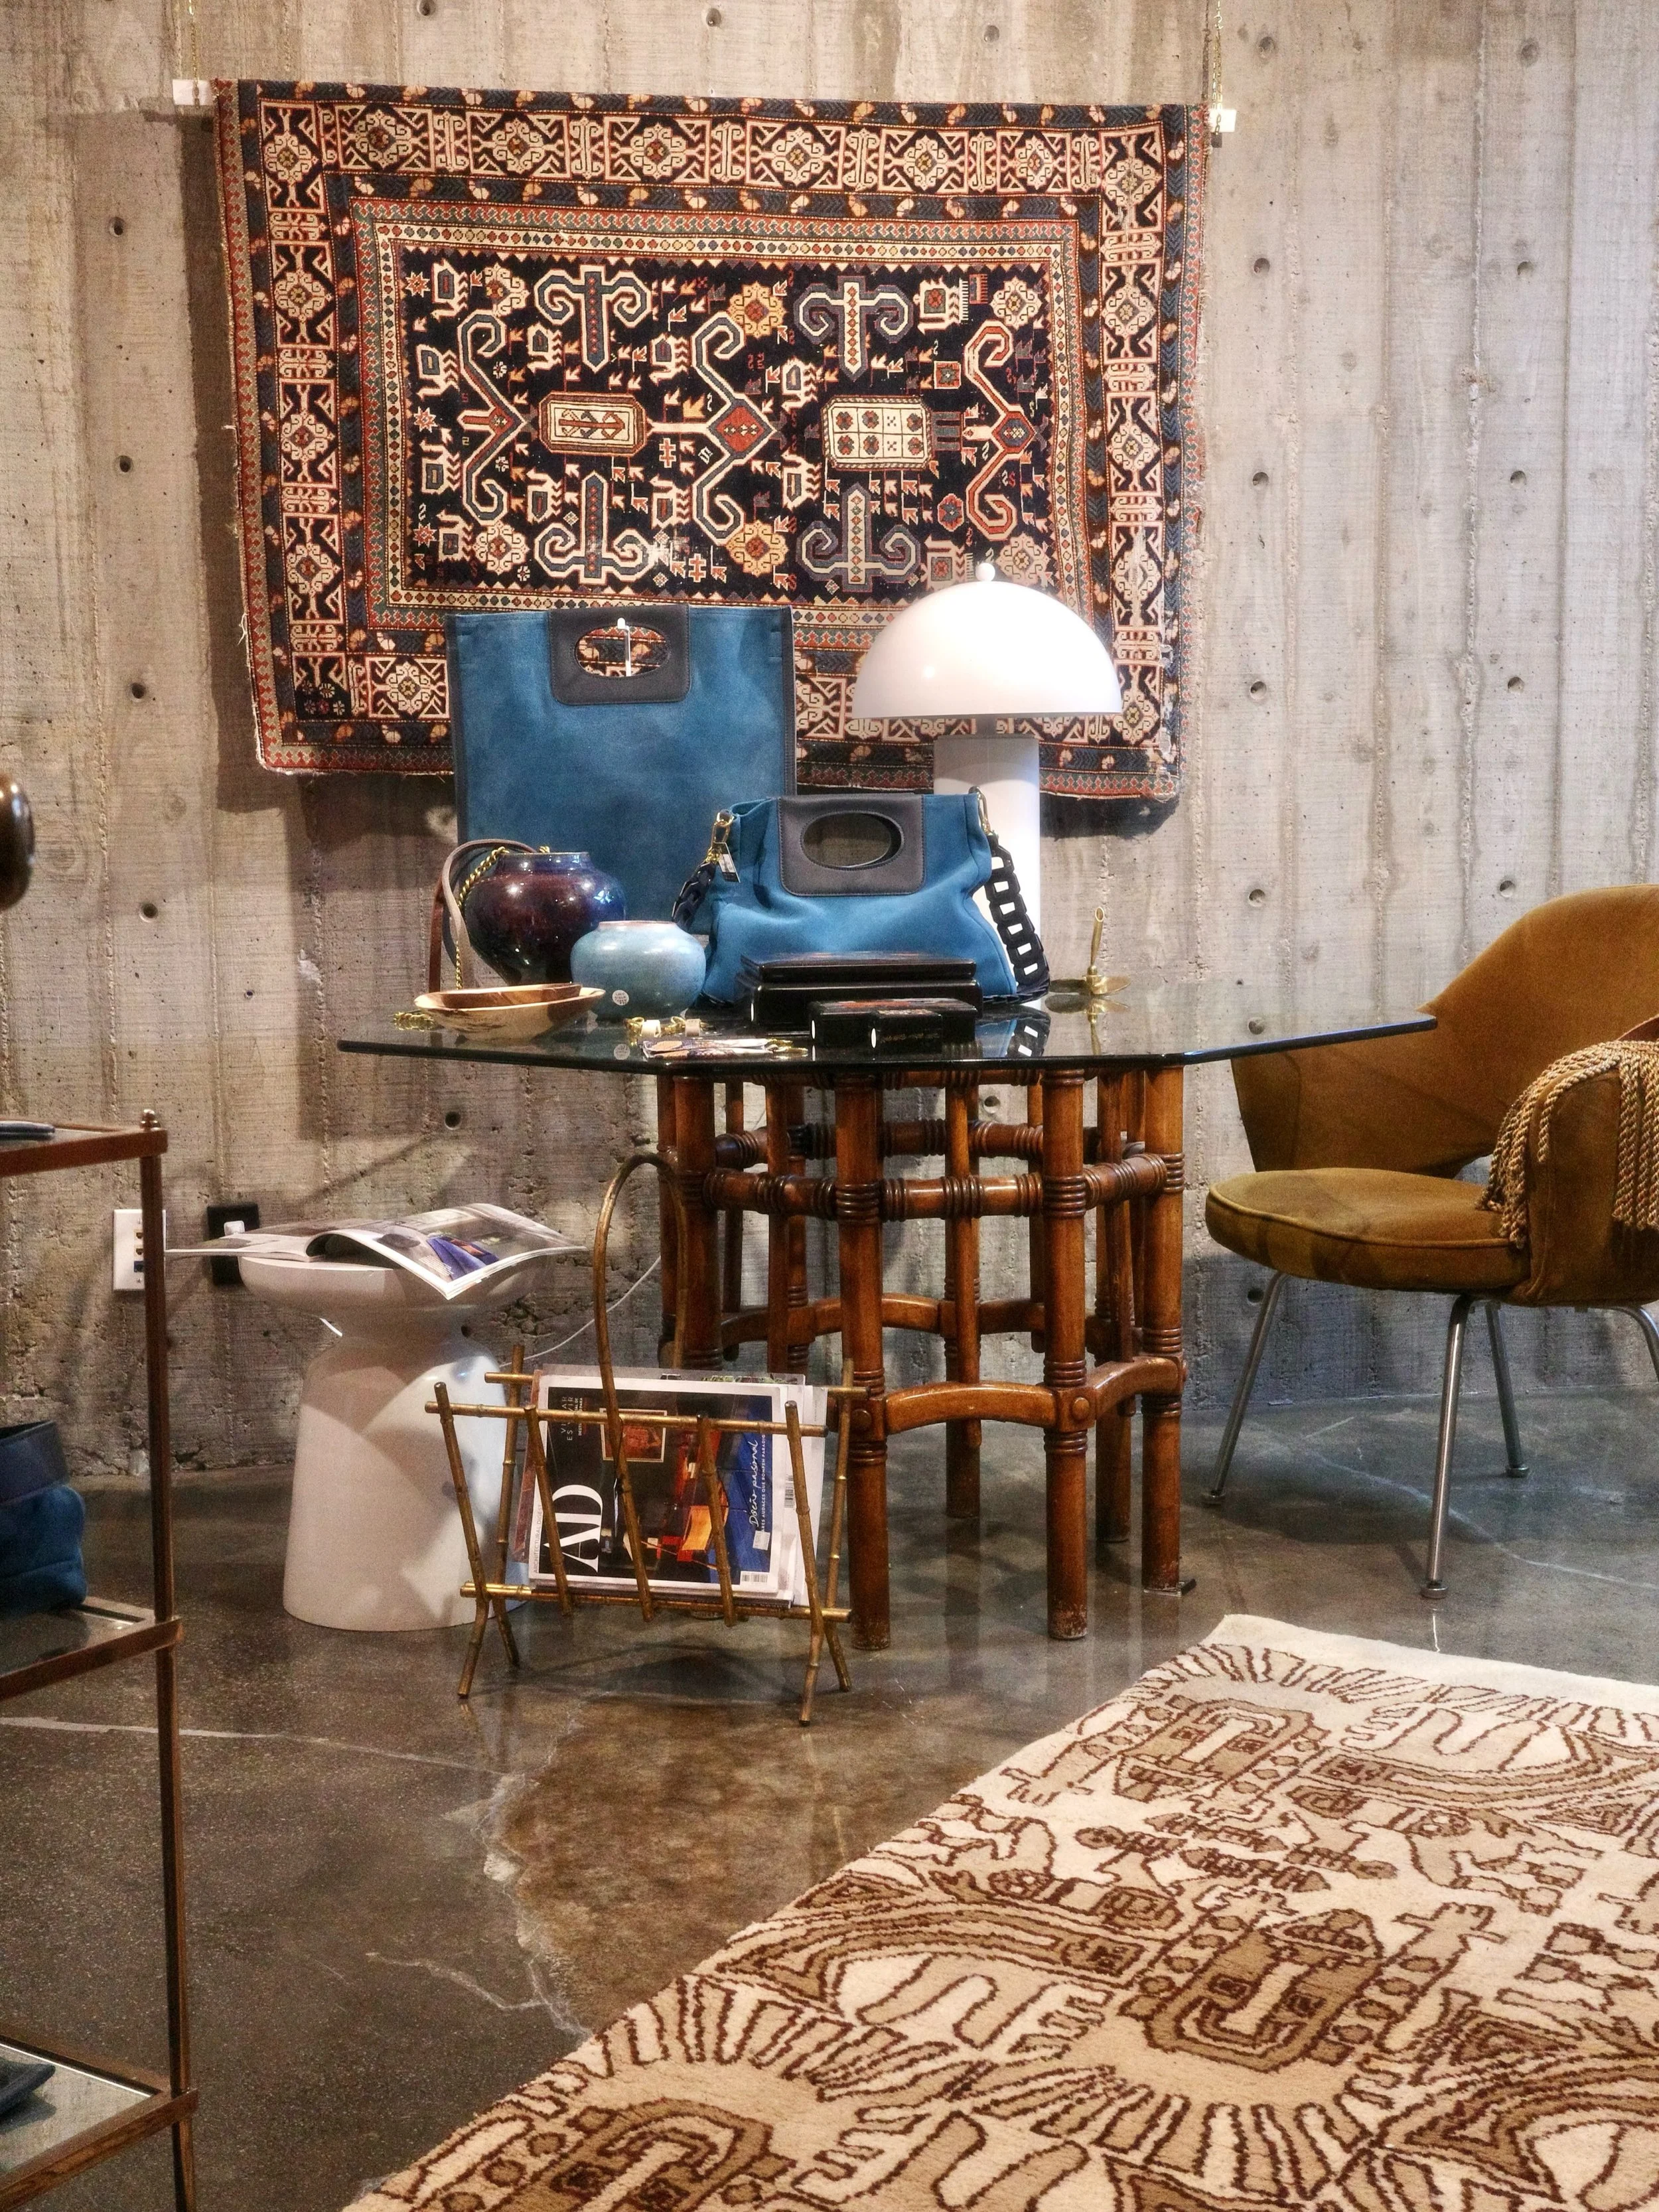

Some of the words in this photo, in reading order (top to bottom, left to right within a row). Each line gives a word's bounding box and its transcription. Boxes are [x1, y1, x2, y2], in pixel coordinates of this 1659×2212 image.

[567, 1430, 573, 1441] ES
[749, 1489, 759, 1527] Diseño
[543, 1484, 603, 1573] AD
